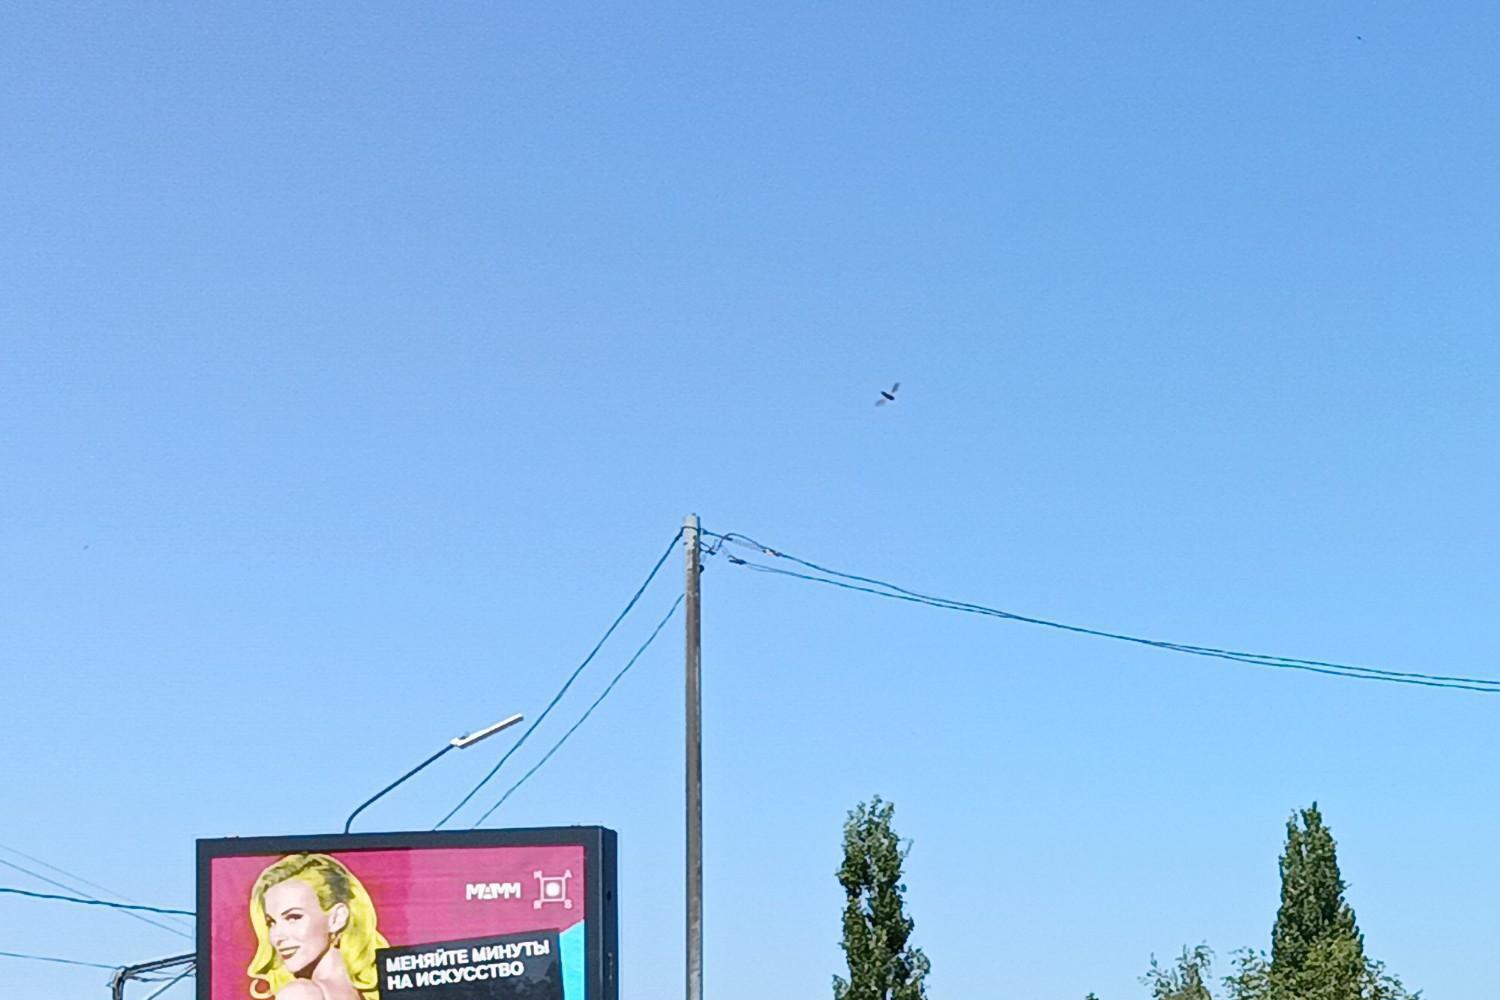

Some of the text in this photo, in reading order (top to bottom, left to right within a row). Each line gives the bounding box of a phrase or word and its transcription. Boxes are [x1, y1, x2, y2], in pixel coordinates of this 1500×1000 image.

[386, 940, 550, 972] МЕНЯЙТЕ МИНУТЫ
[387, 961, 525, 990] НА ИСКУССТВО
